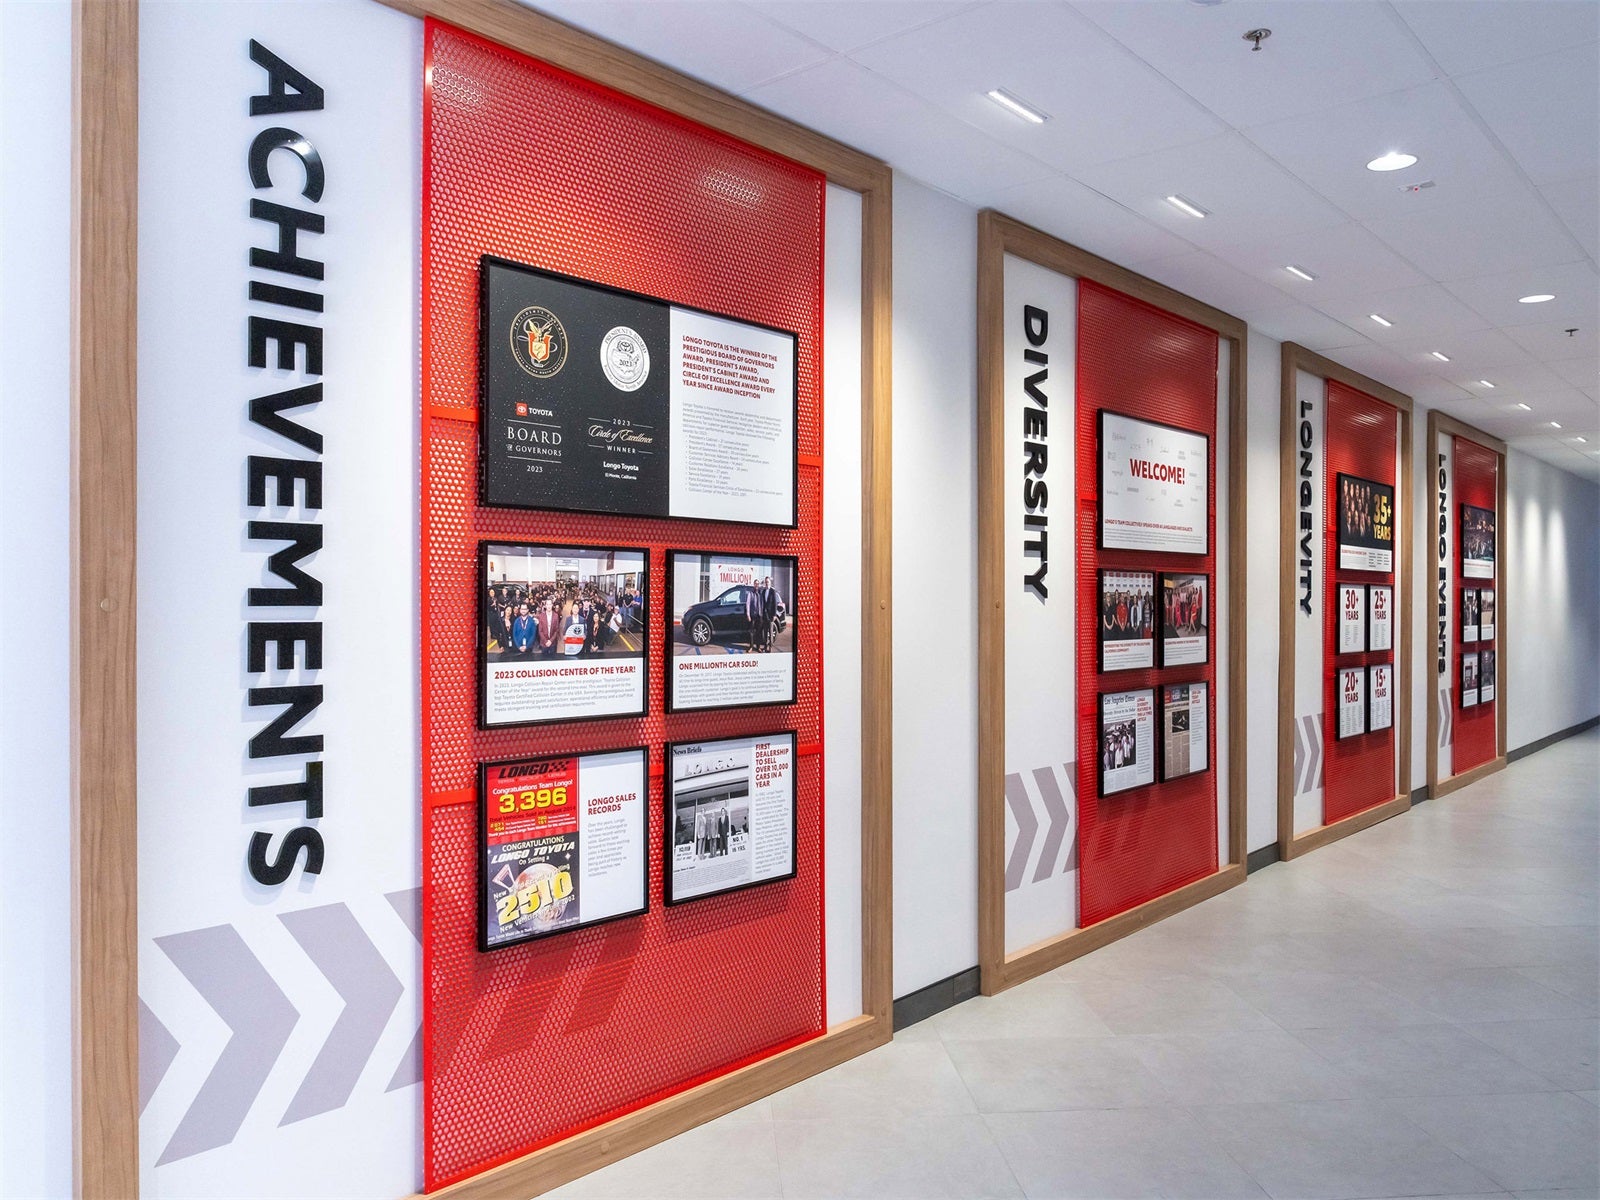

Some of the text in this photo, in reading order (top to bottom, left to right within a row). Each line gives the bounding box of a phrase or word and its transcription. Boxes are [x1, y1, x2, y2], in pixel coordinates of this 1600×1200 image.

[683, 336, 702, 344] LONGO
[703, 340, 723, 350] TOYOTA
[740, 348, 760, 357] WINNER
[683, 344, 717, 356] PRESTIGIOUS
[718, 352, 736, 360] BOARD
[744, 358, 774, 369] GOVERNORS
[683, 353, 759, 375] AWARD, PRESIDENT'S AWARD,
[683, 362, 716, 373] PRESIDENT'S
[717, 369, 738, 379] CABINET
[683, 371, 700, 380] CIRCLE
[710, 376, 740, 387] EXCELLENCE
[742, 382, 760, 390] AWARD
[714, 386, 733, 394] AWARD
[734, 390, 760, 399] INCEPTION
[529, 407, 553, 416] TOYOTA
[613, 418, 631, 426] 2023
[508, 427, 561, 445] BOARD
[588, 425, 610, 438] Circle
[619, 429, 653, 443] Excellence
[516, 445, 562, 457] GOVERNORS
[607, 445, 636, 454] WINNER
[1024, 304, 1048, 599] DIVERSITY
[248, 38, 324, 887] ACHIEVEMENTS
[603, 461, 639, 471] Longo Toyota
[1130, 458, 1185, 485] WELCOME!
[1301, 400, 1312, 615] LONGEVITY
[1374, 494, 1391, 524] 35+
[1374, 524, 1391, 540] YEARS
[1346, 589, 1359, 609] 30+
[1375, 590, 1386, 609] 25+
[1346, 611, 1358, 620] YEARS
[1375, 610, 1386, 620] YEARS
[495, 671, 514, 679] 2023
[516, 669, 558, 678] COLLISION
[559, 668, 588, 677] CENTER
[1345, 671, 1358, 692] 20+
[1376, 668, 1386, 688] 15+
[1345, 692, 1358, 703] YEARS
[1375, 688, 1386, 698] YEARS
[756, 748, 789, 758] DEALERSHIP
[499, 763, 549, 778] LONGO
[756, 763, 788, 773] OVER 10,000
[756, 772, 770, 780] CARS
[493, 784, 538, 795] Congratulations
[499, 787, 566, 813] 3,396
[588, 793, 636, 807] LONGO SALES
[588, 804, 621, 815] RECORDS
[502, 836, 564, 852] CONGRATULATIONS
[491, 841, 575, 864] LONGO TOYOTA
[494, 890, 507, 900] New
[496, 871, 573, 926] 2510
[500, 924, 513, 933] New
